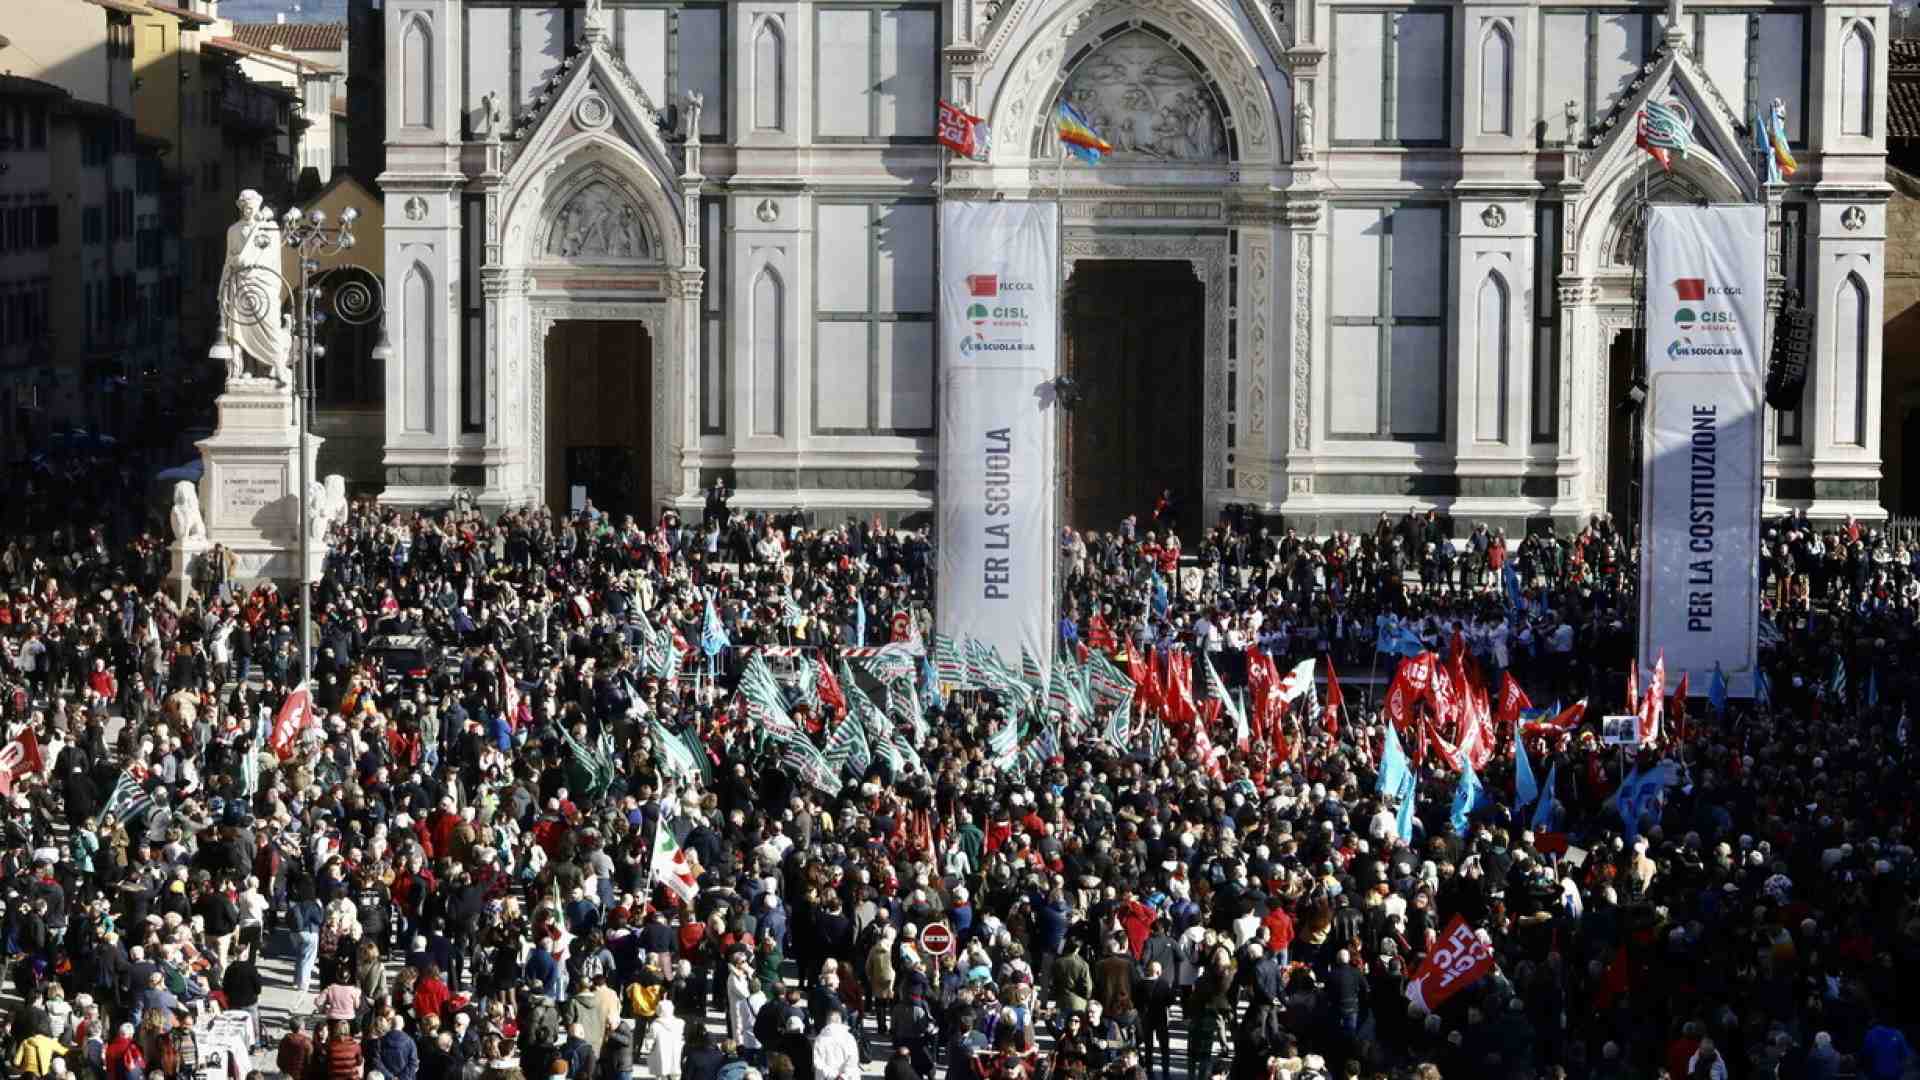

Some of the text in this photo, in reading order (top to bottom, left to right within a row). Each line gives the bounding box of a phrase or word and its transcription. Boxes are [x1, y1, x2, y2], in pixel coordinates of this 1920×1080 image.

[993, 307, 1028, 319] CISL
[1700, 311, 1736, 323] CISL
[983, 343, 1016, 351] SCUOLA
[1691, 347, 1724, 356] SCUOLA
[984, 427, 1011, 600] PER LA SCUOLA
[1687, 404, 1717, 632] PER LA COSTITUZIONE
